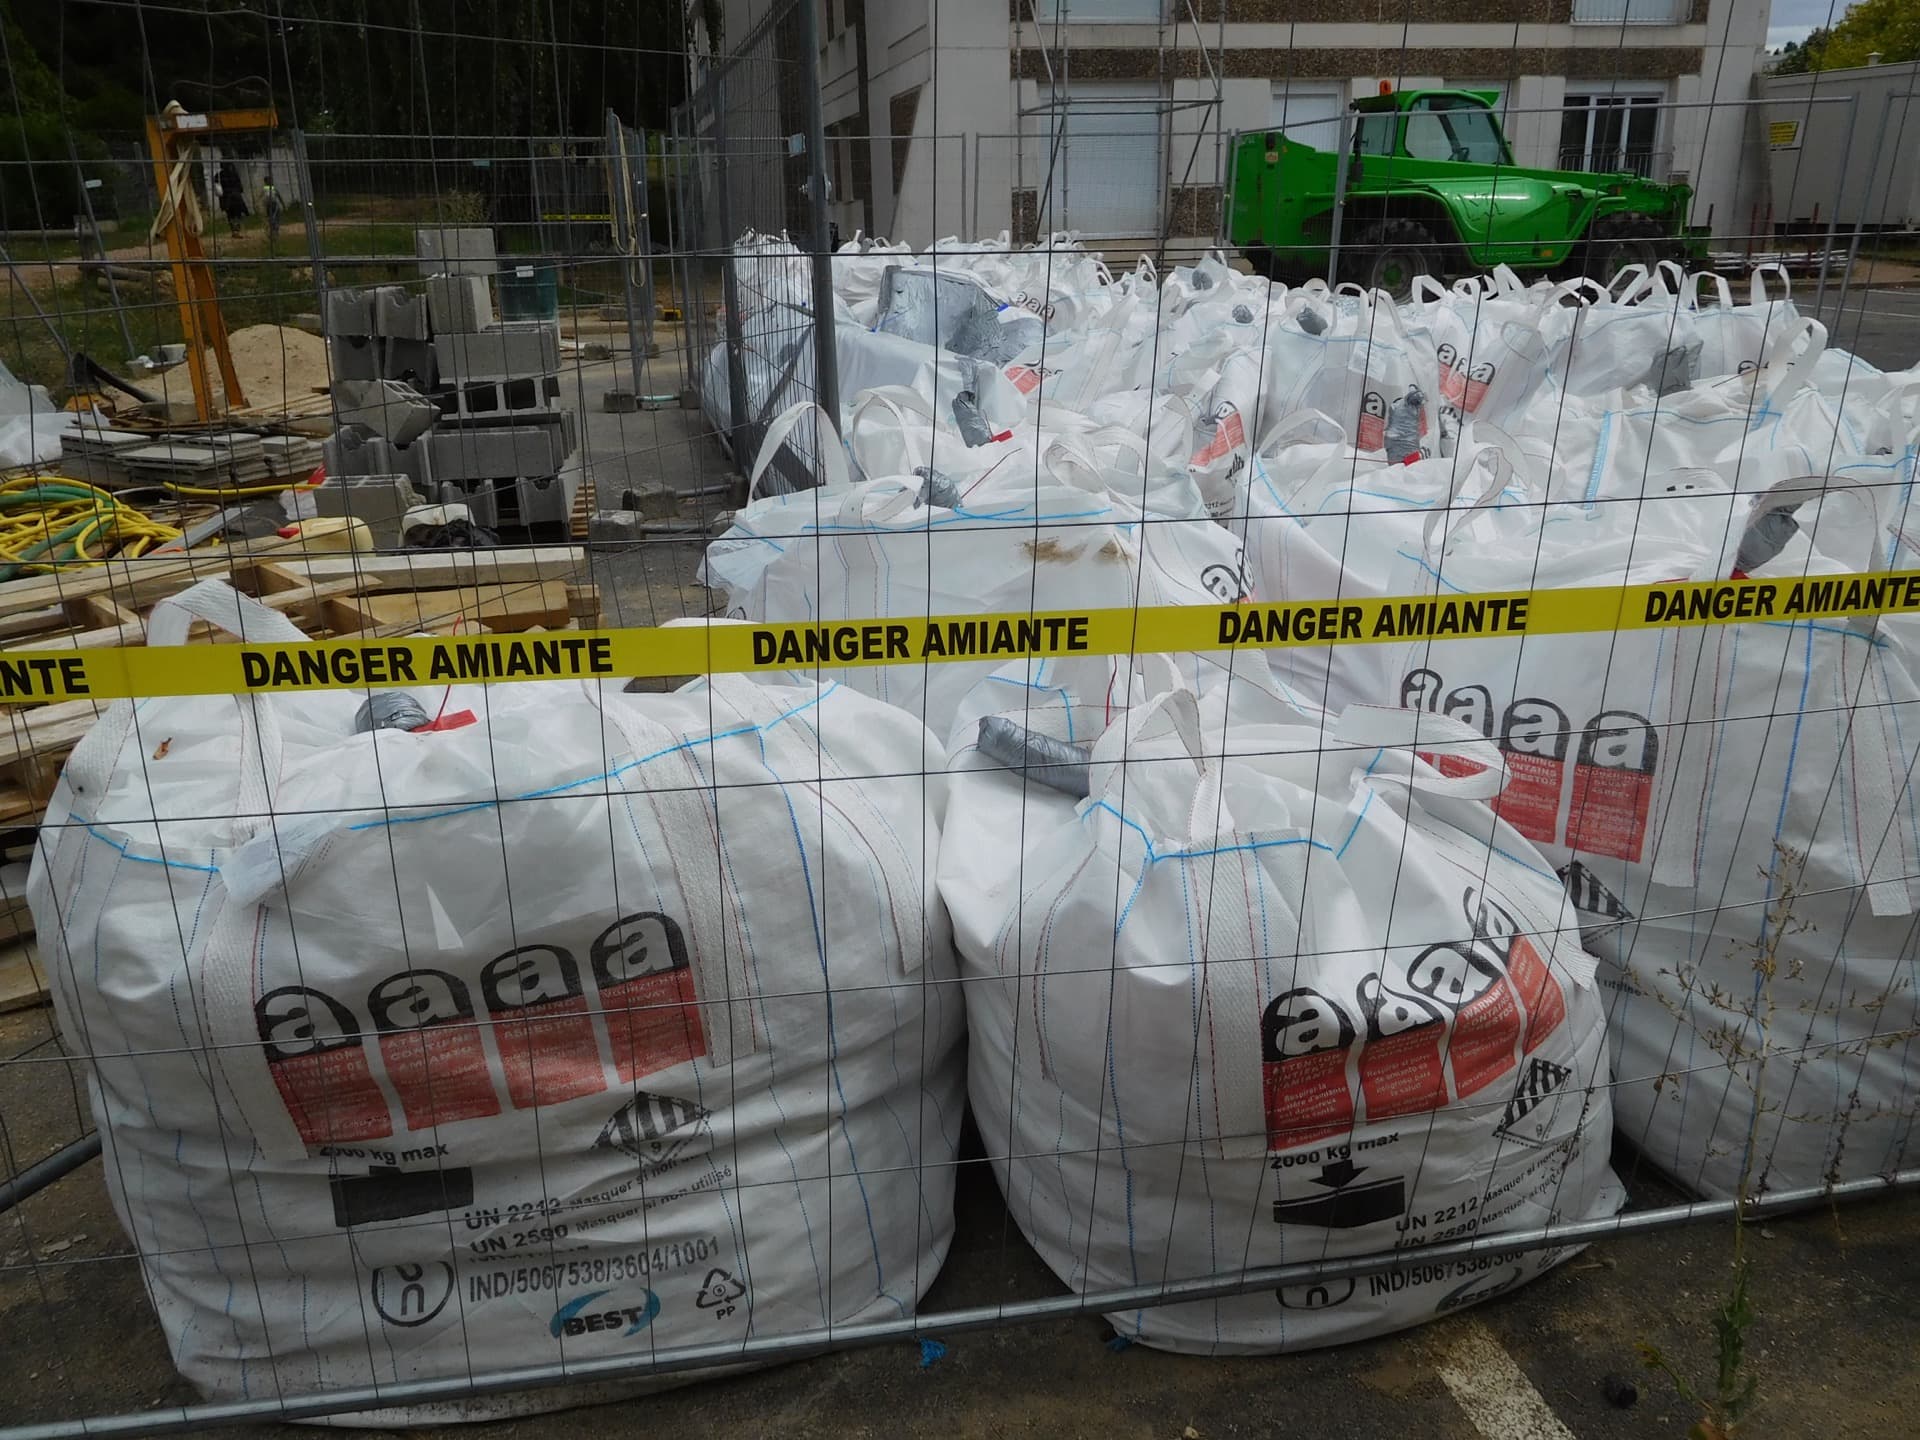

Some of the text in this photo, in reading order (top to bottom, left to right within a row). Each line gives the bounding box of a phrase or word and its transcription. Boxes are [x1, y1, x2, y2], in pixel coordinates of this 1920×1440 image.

[1364, 391, 1385, 418] a
[241, 645, 415, 688] DANGER
[430, 638, 613, 680] AMIANTE
[752, 624, 911, 666] DANGER
[922, 617, 1089, 657] AMIANTE
[1217, 606, 1363, 644] DANGER
[1373, 598, 1529, 637] AMIANTE
[1645, 585, 1777, 622] DANGER
[1783, 576, 1920, 614] AMIANTE
[1504, 700, 1564, 757] a
[1586, 712, 1650, 770] a
[1507, 762, 1557, 777] ONTAINS
[1511, 772, 1557, 786] BESTOS
[261, 914, 676, 1056] a a a a
[1267, 989, 1345, 1056] a
[1410, 945, 1496, 1005] a
[401, 1143, 449, 1162] max
[1270, 1131, 1399, 1170] 2000 kg max
[465, 1207, 500, 1229] UN
[470, 1236, 507, 1254] UN
[513, 1224, 568, 1248] 2590
[576, 1207, 639, 1232] Masquer
[691, 1165, 732, 1191] utilisé
[1395, 1215, 1427, 1232] UN
[1434, 1196, 1479, 1225] 2212
[563, 1306, 642, 1337] BEST
[717, 1306, 736, 1320] PP
